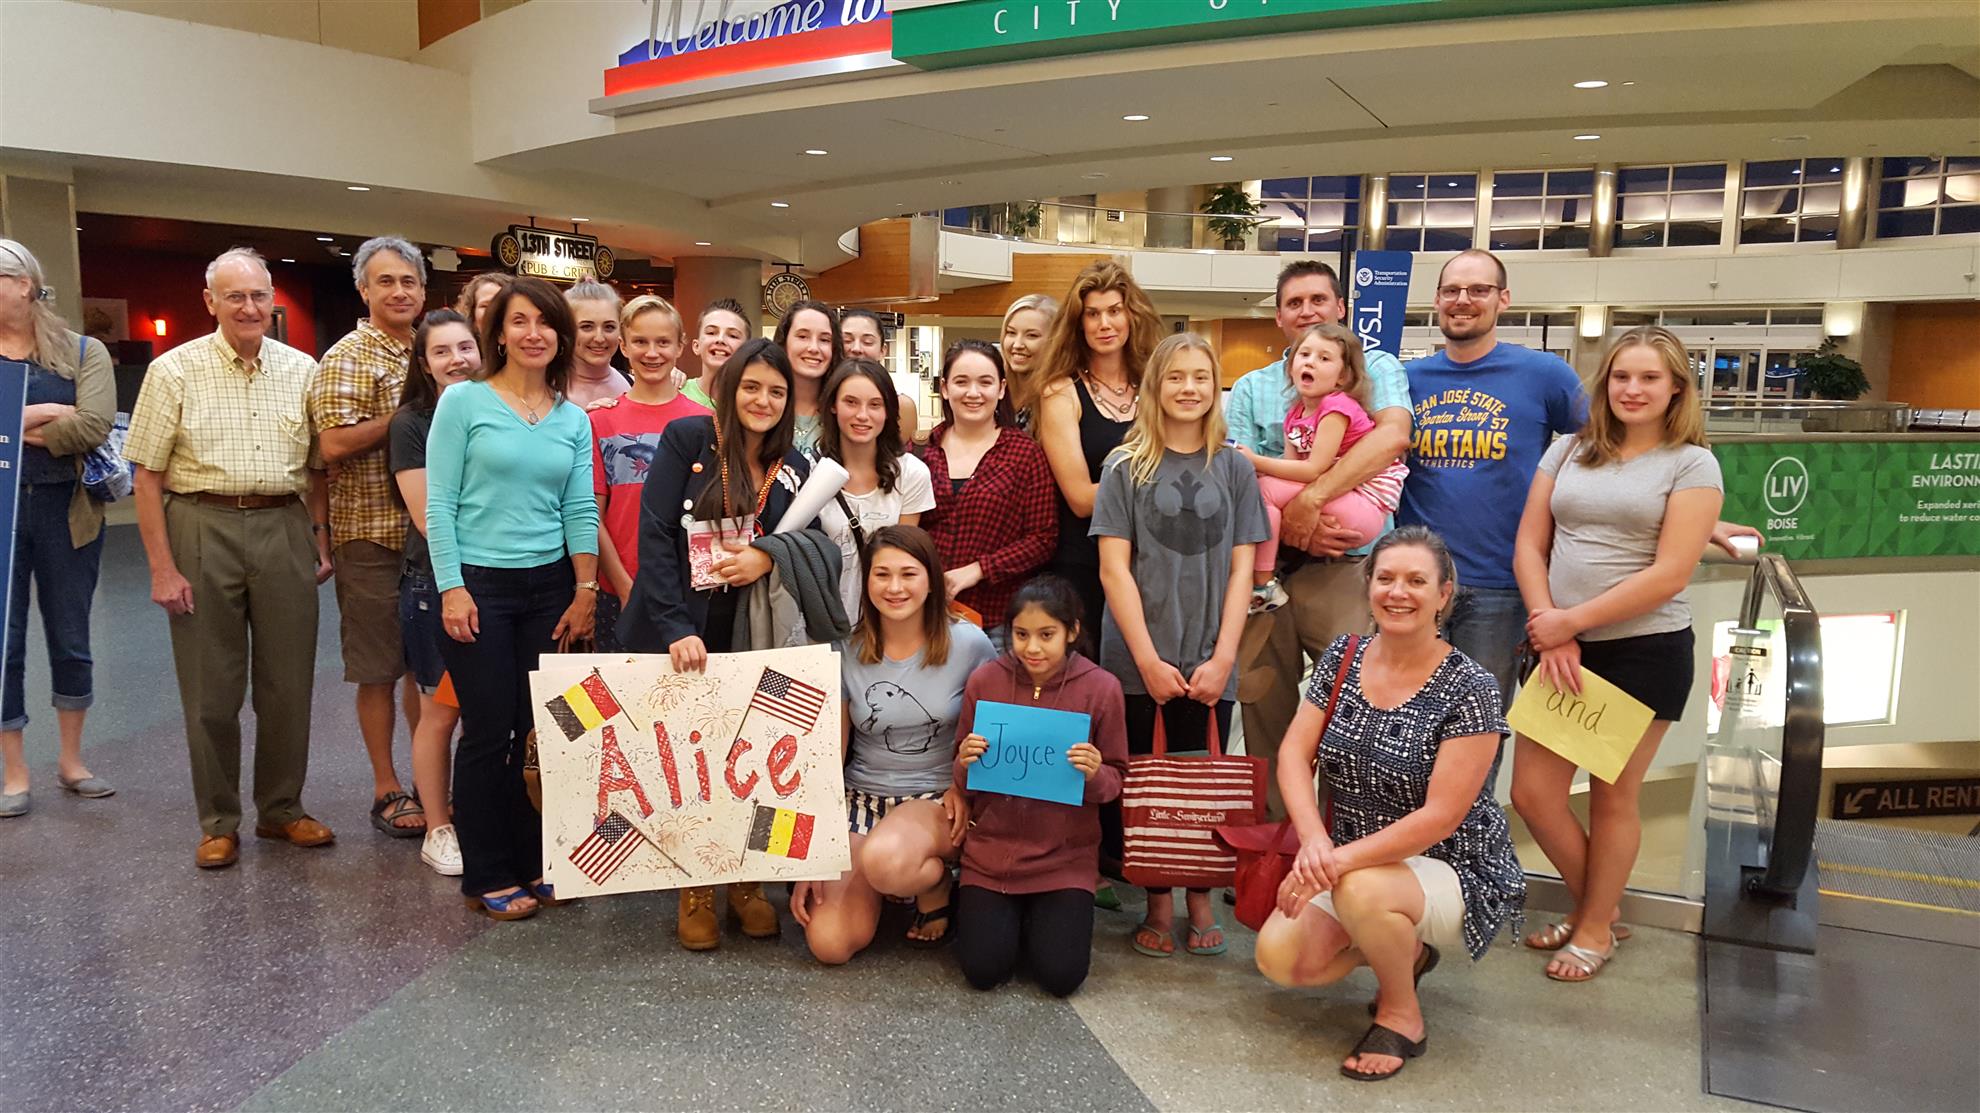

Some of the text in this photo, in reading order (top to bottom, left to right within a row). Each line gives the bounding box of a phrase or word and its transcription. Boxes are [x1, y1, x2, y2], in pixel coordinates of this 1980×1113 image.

[993, 0, 1121, 34] CITY
[643, 0, 884, 60] Welcome to
[521, 232, 595, 261] 13TH STREET
[527, 262, 548, 275] PUB
[551, 264, 559, 276] &
[1358, 300, 1383, 353] TSA
[1414, 394, 1438, 416] SAN
[1470, 390, 1507, 417] STATE
[1456, 406, 1490, 428] Strong
[1490, 417, 1510, 431] 57
[1770, 475, 1804, 498] LIV
[1899, 513, 1909, 522] to
[1910, 513, 1941, 522] reduce
[1942, 513, 1968, 522] water
[1917, 500, 1962, 512] Expanded
[1766, 518, 1799, 530] BOISE
[1545, 690, 1607, 736] and
[979, 722, 1056, 781] Joyce
[593, 720, 801, 828] Alice
[1877, 788, 1920, 810] ALL
